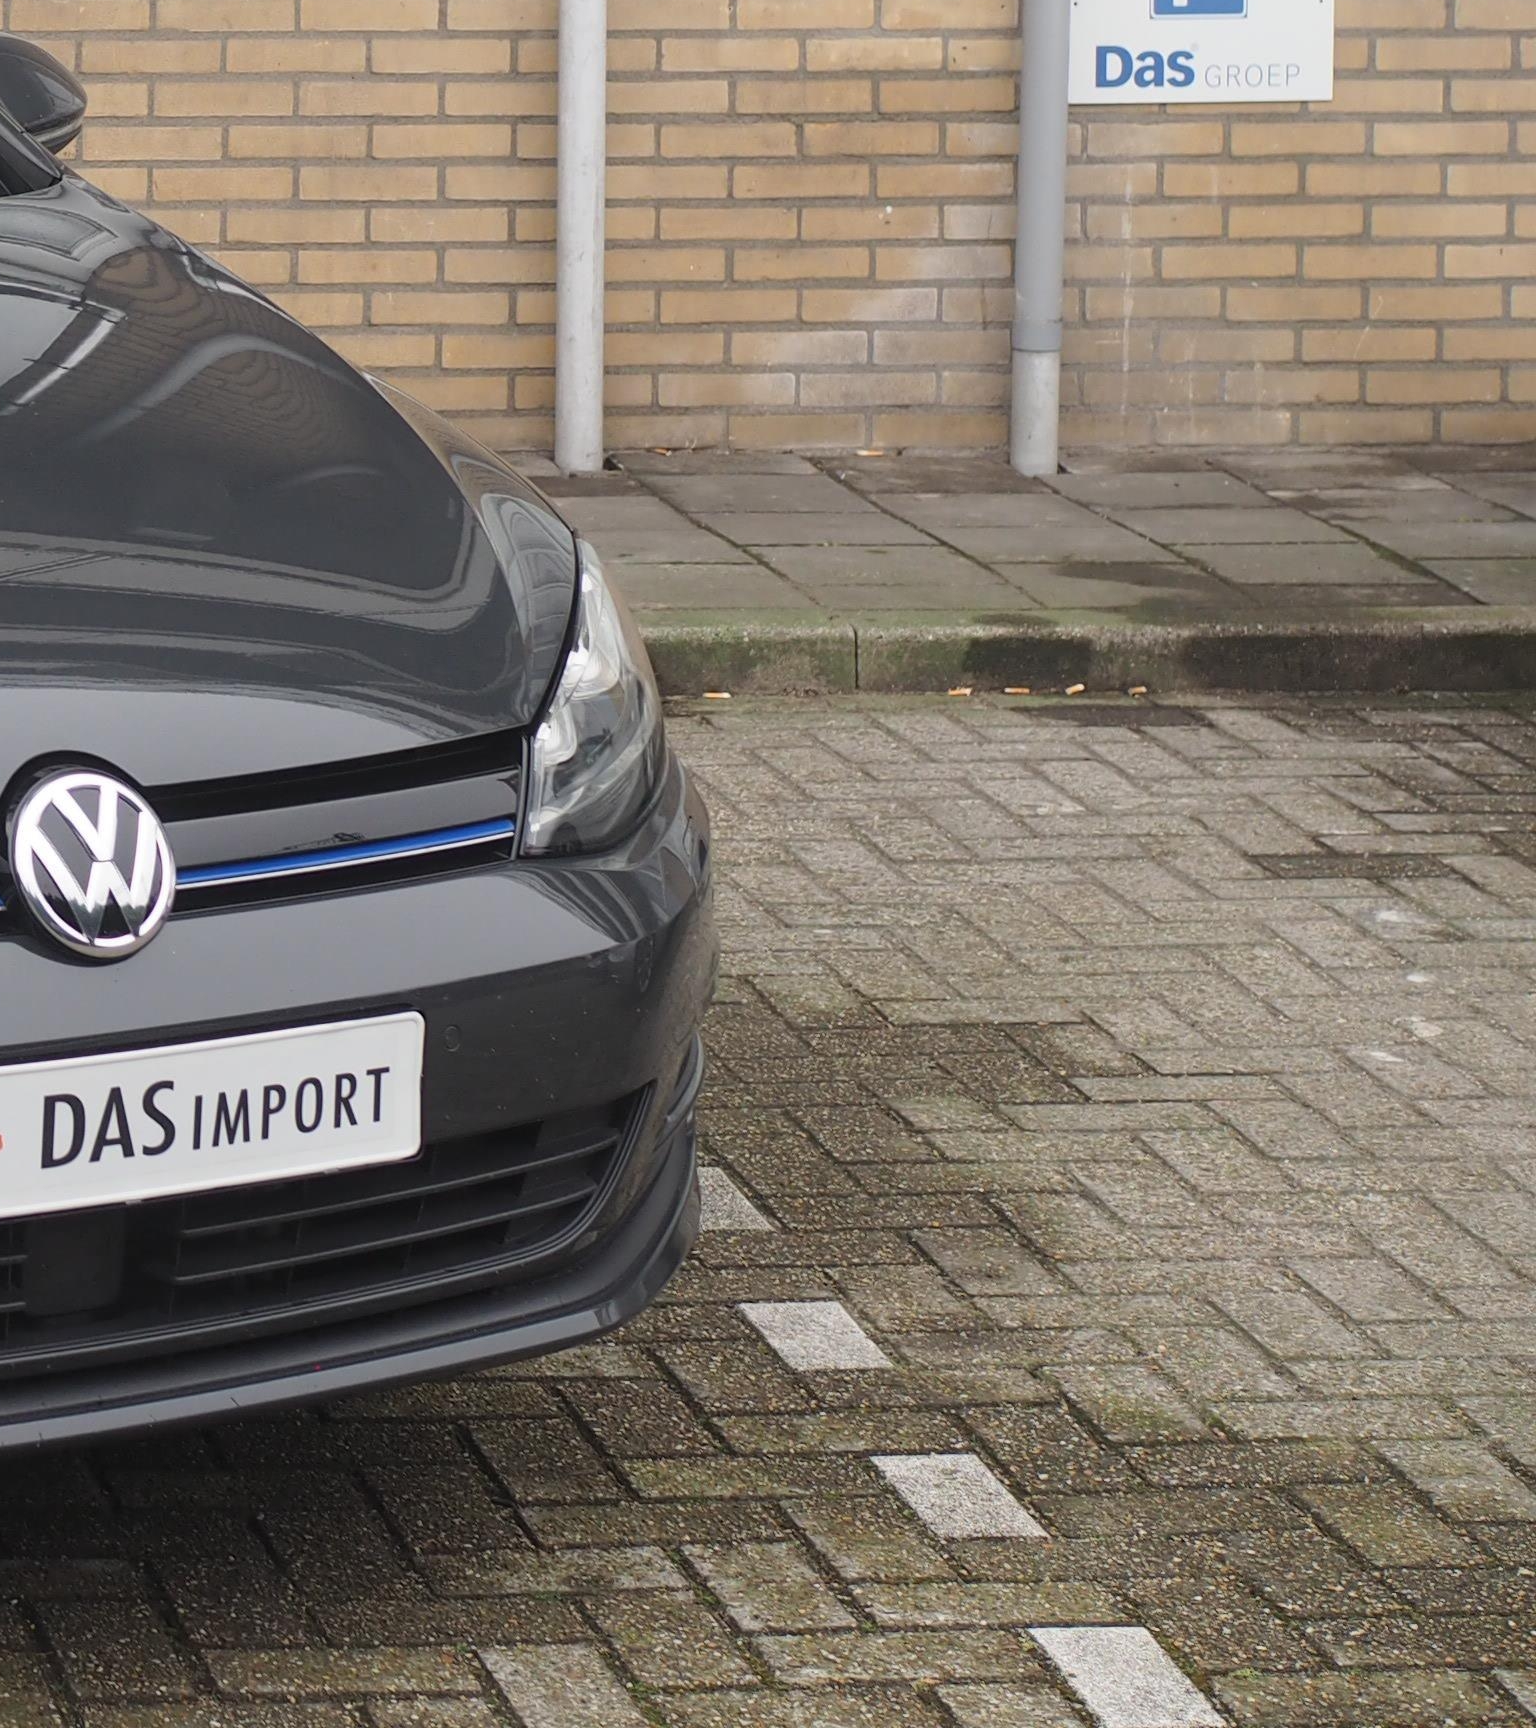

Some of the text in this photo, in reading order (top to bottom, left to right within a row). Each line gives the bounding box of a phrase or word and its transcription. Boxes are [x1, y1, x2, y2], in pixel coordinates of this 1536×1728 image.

[1095, 45, 1301, 88] Das GROEP
[40, 1065, 391, 1170] DAS IMPORT
